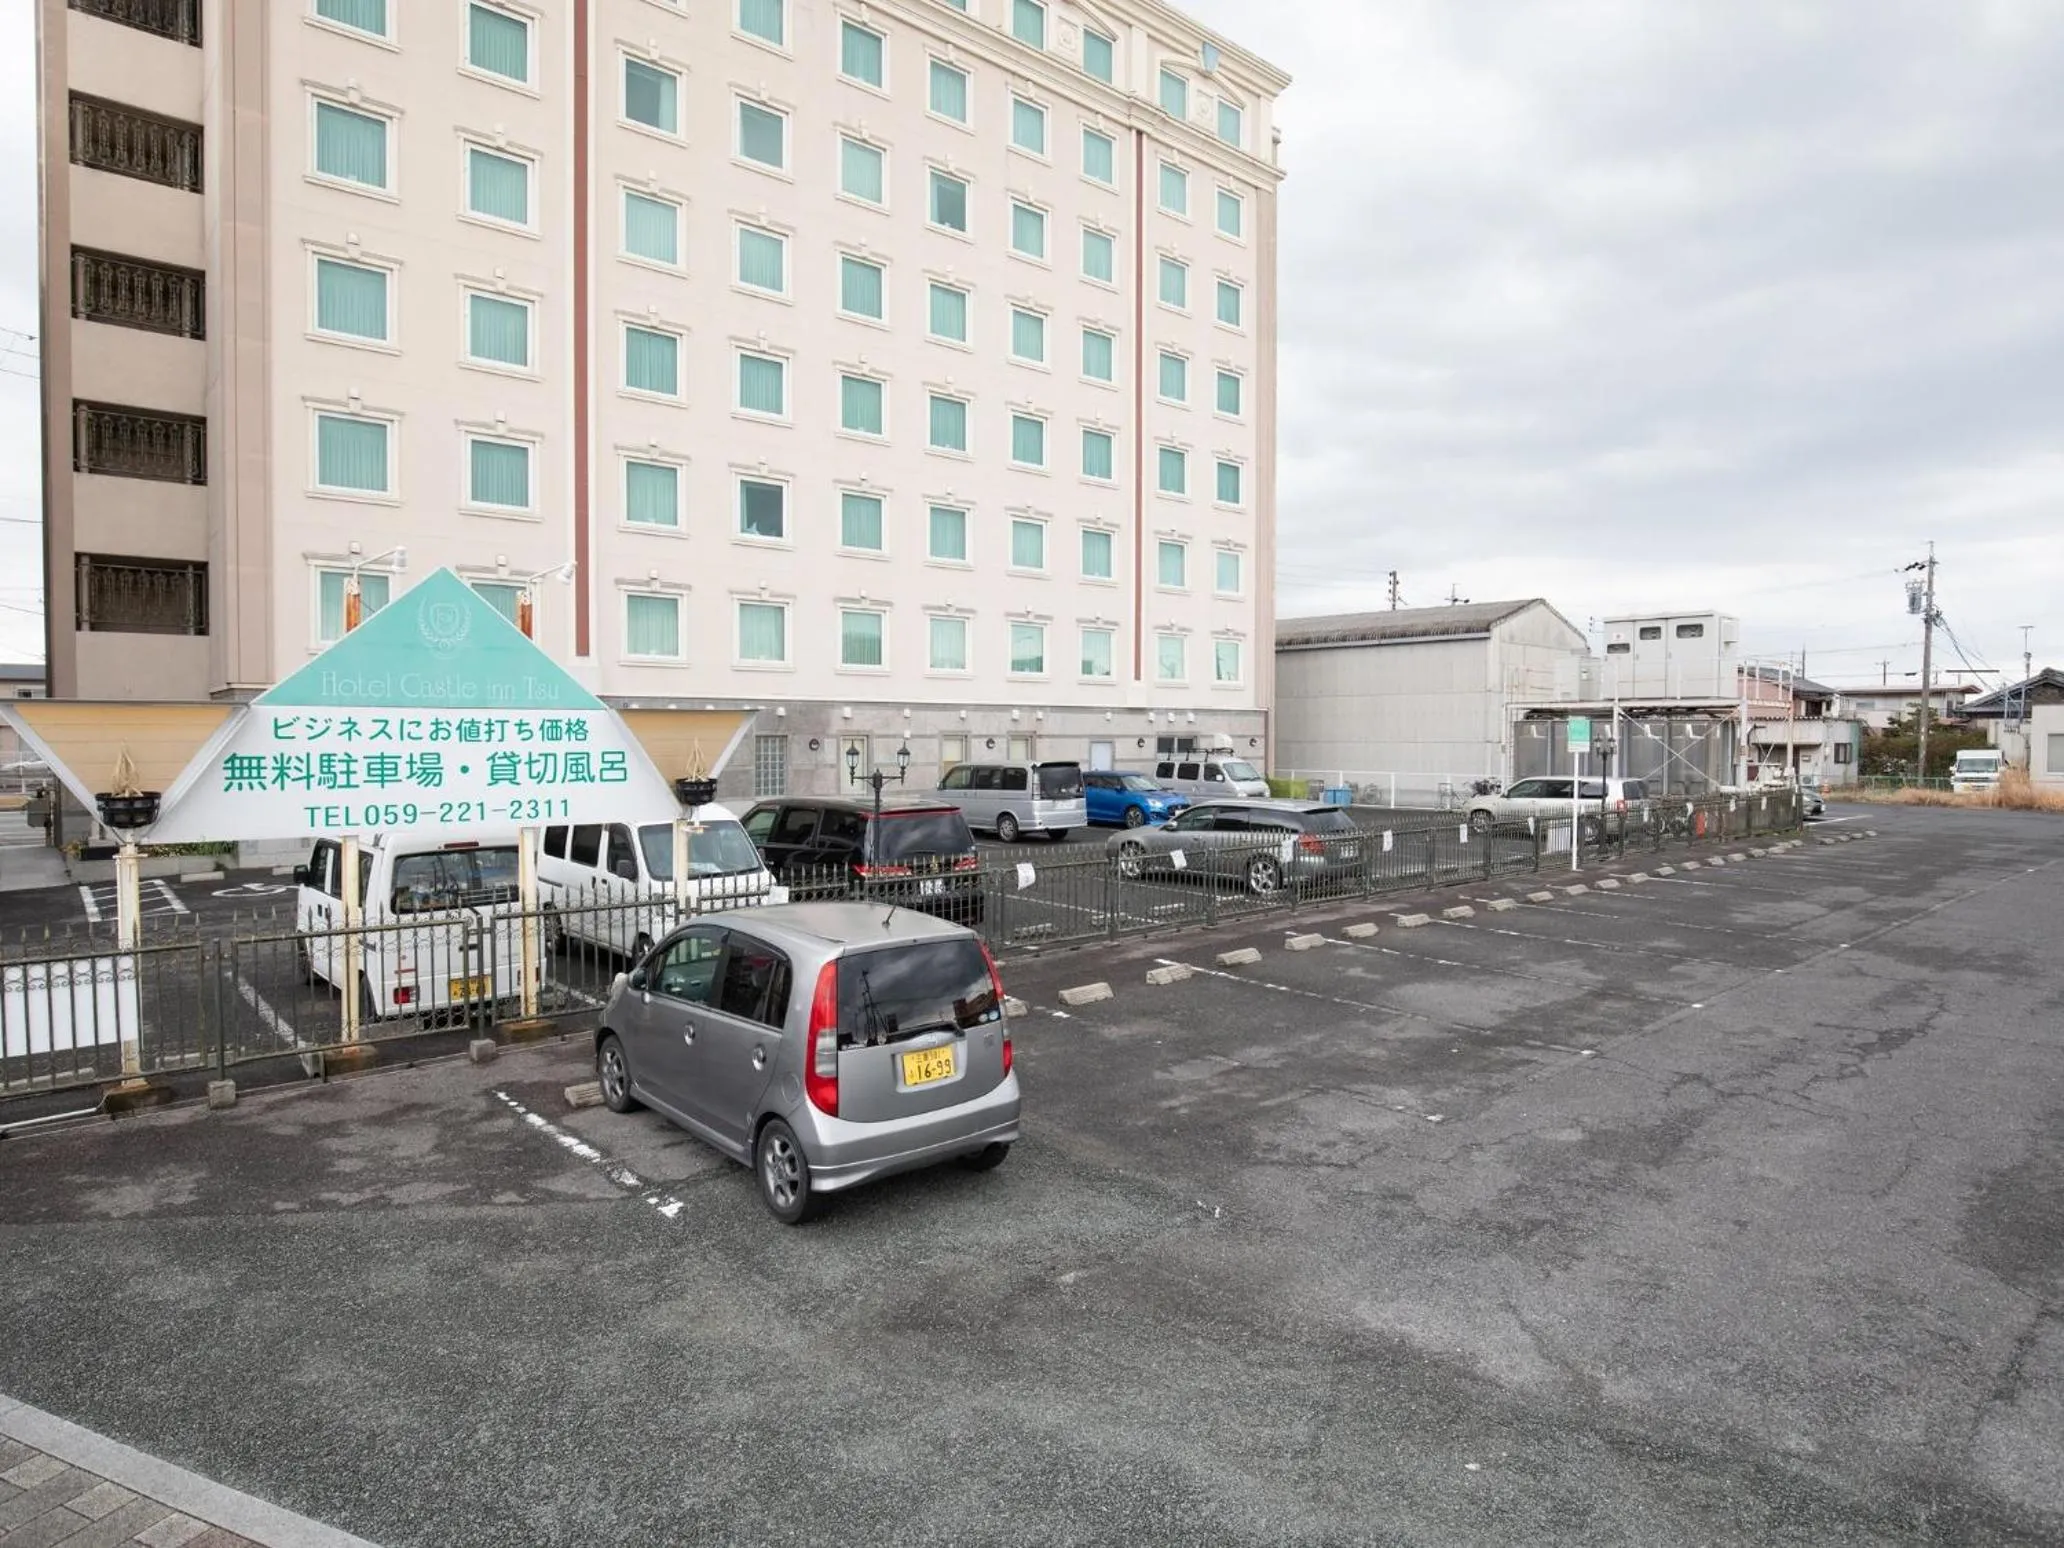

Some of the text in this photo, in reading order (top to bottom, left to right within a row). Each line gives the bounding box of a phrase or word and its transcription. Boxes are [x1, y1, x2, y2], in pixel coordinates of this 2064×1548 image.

[321, 670, 391, 698] Hotel
[400, 672, 477, 699] Castle
[522, 675, 560, 700] Tsu
[273, 716, 589, 743] ビジネスにお値打ち価格
[222, 750, 628, 792] 無料駐車場・貸切風呂
